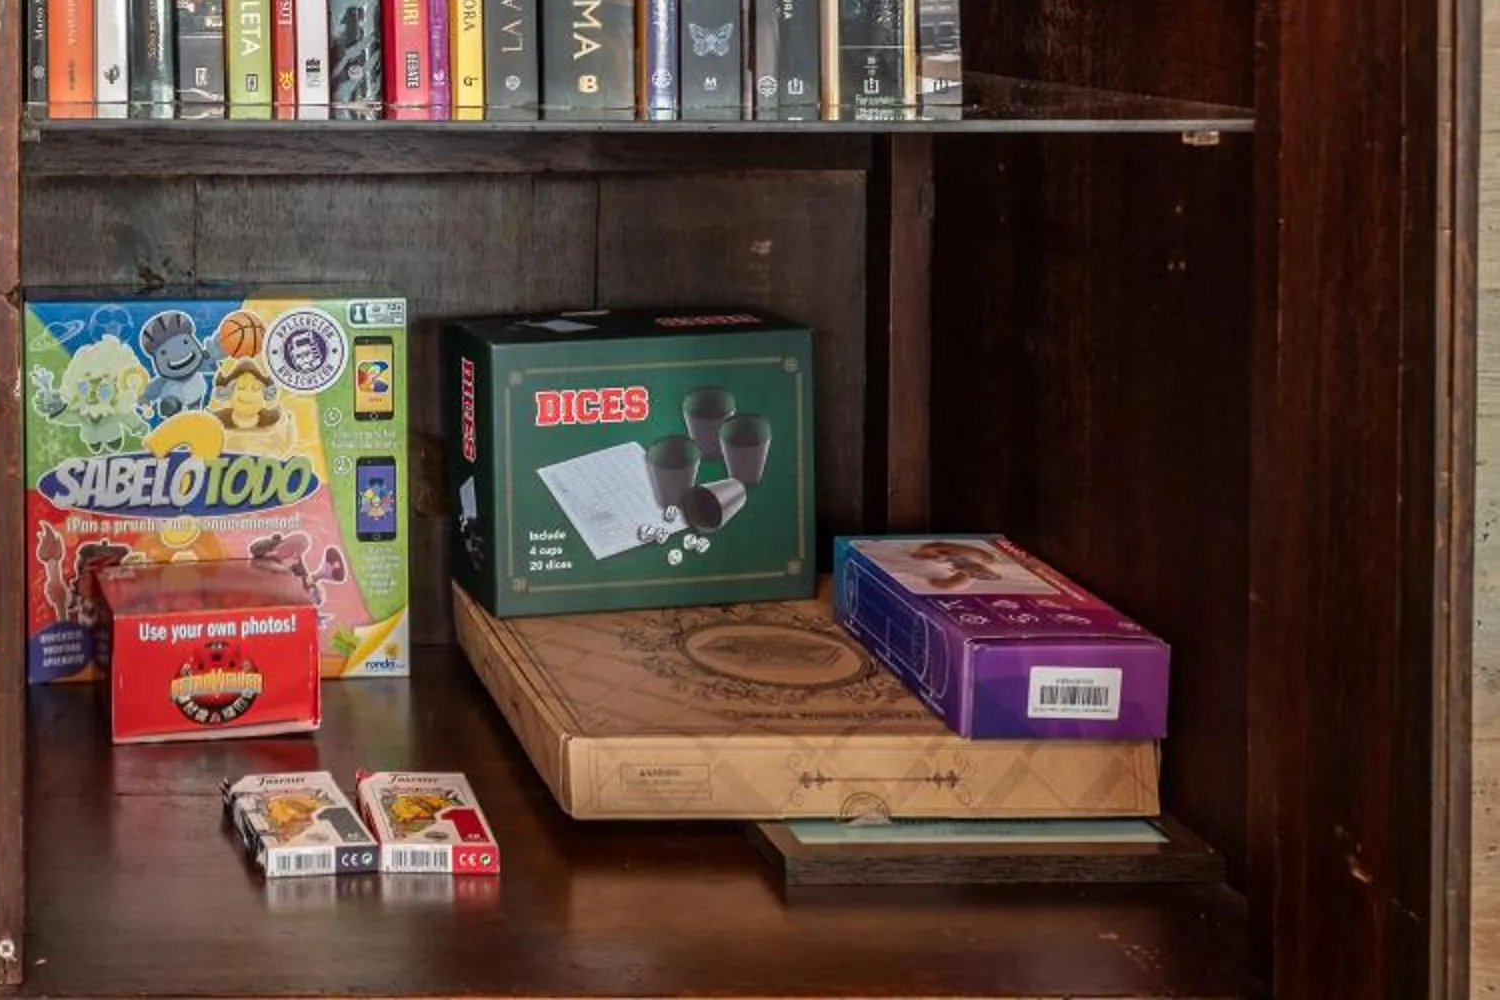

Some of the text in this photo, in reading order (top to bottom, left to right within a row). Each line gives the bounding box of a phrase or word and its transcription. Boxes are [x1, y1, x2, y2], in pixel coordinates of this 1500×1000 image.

[502, 19, 523, 52] LA
[407, 52, 420, 88] DEBATE
[461, 357, 477, 463] DICES
[535, 386, 649, 427] DICES
[53, 455, 313, 509] SABELOTODO
[529, 530, 566, 542] Include
[529, 545, 563, 558] 4 cups
[529, 559, 572, 571] 20 dices
[139, 614, 296, 644] Use your own photos!
